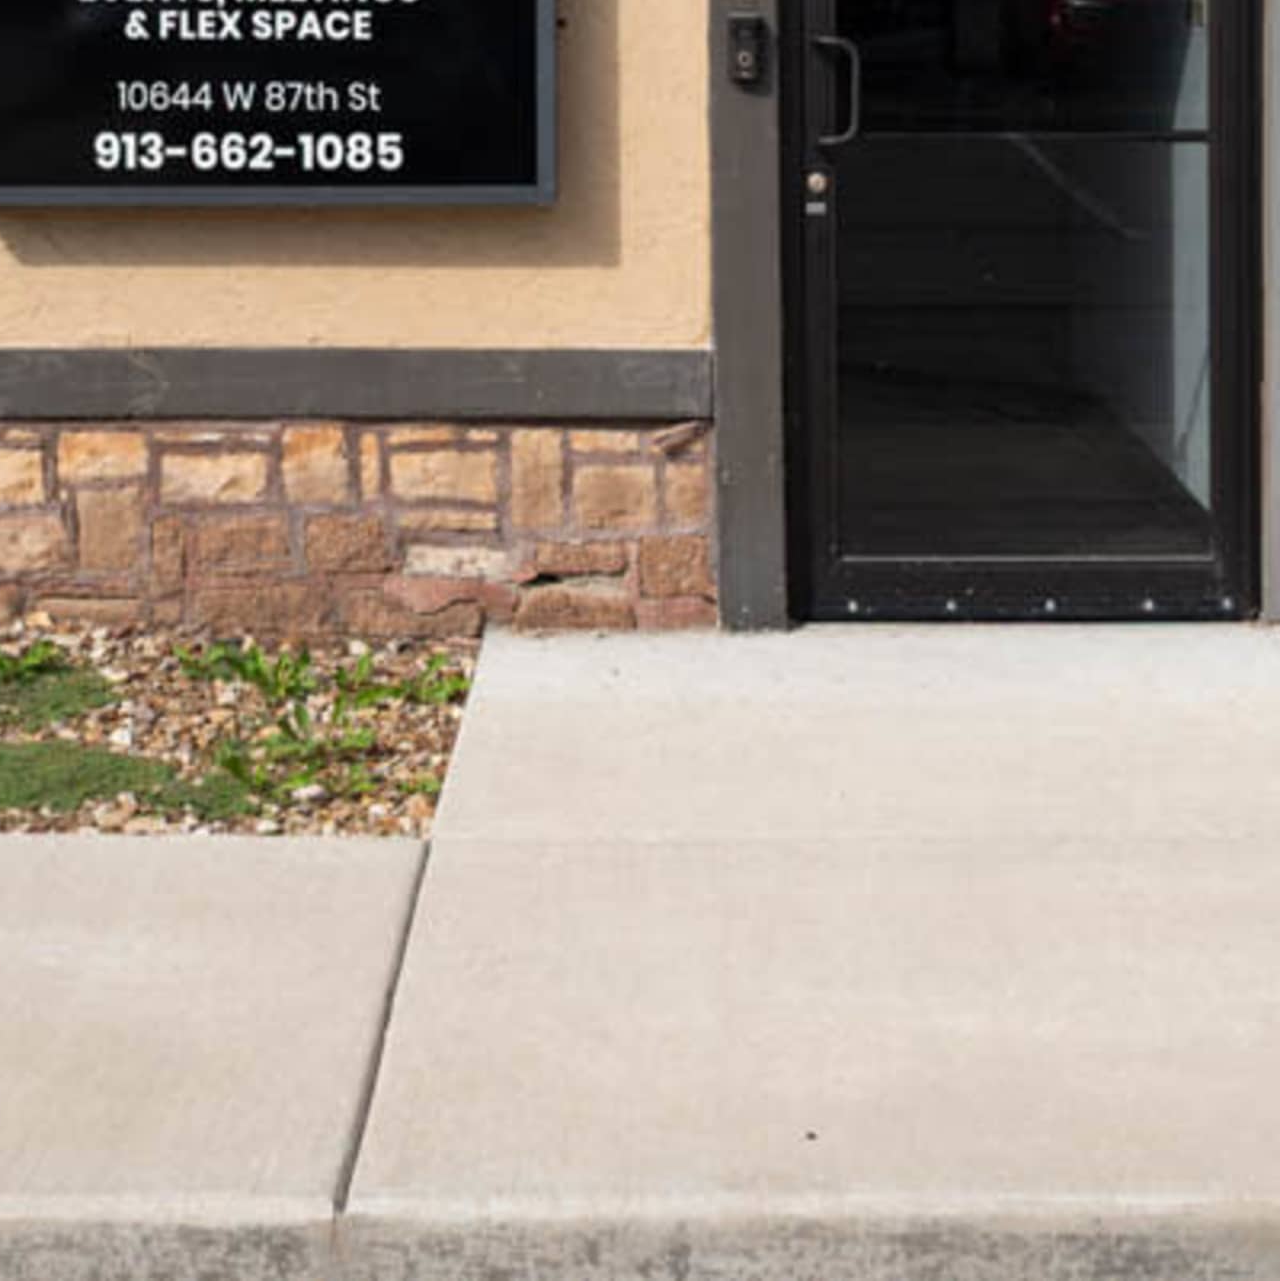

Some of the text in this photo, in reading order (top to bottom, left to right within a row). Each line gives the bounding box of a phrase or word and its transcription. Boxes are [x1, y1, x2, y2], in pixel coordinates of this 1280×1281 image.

[125, 9, 371, 40] & FLEX SPACE
[118, 81, 380, 111] 10644 W 87th St
[94, 132, 403, 170] 913-662-1085
